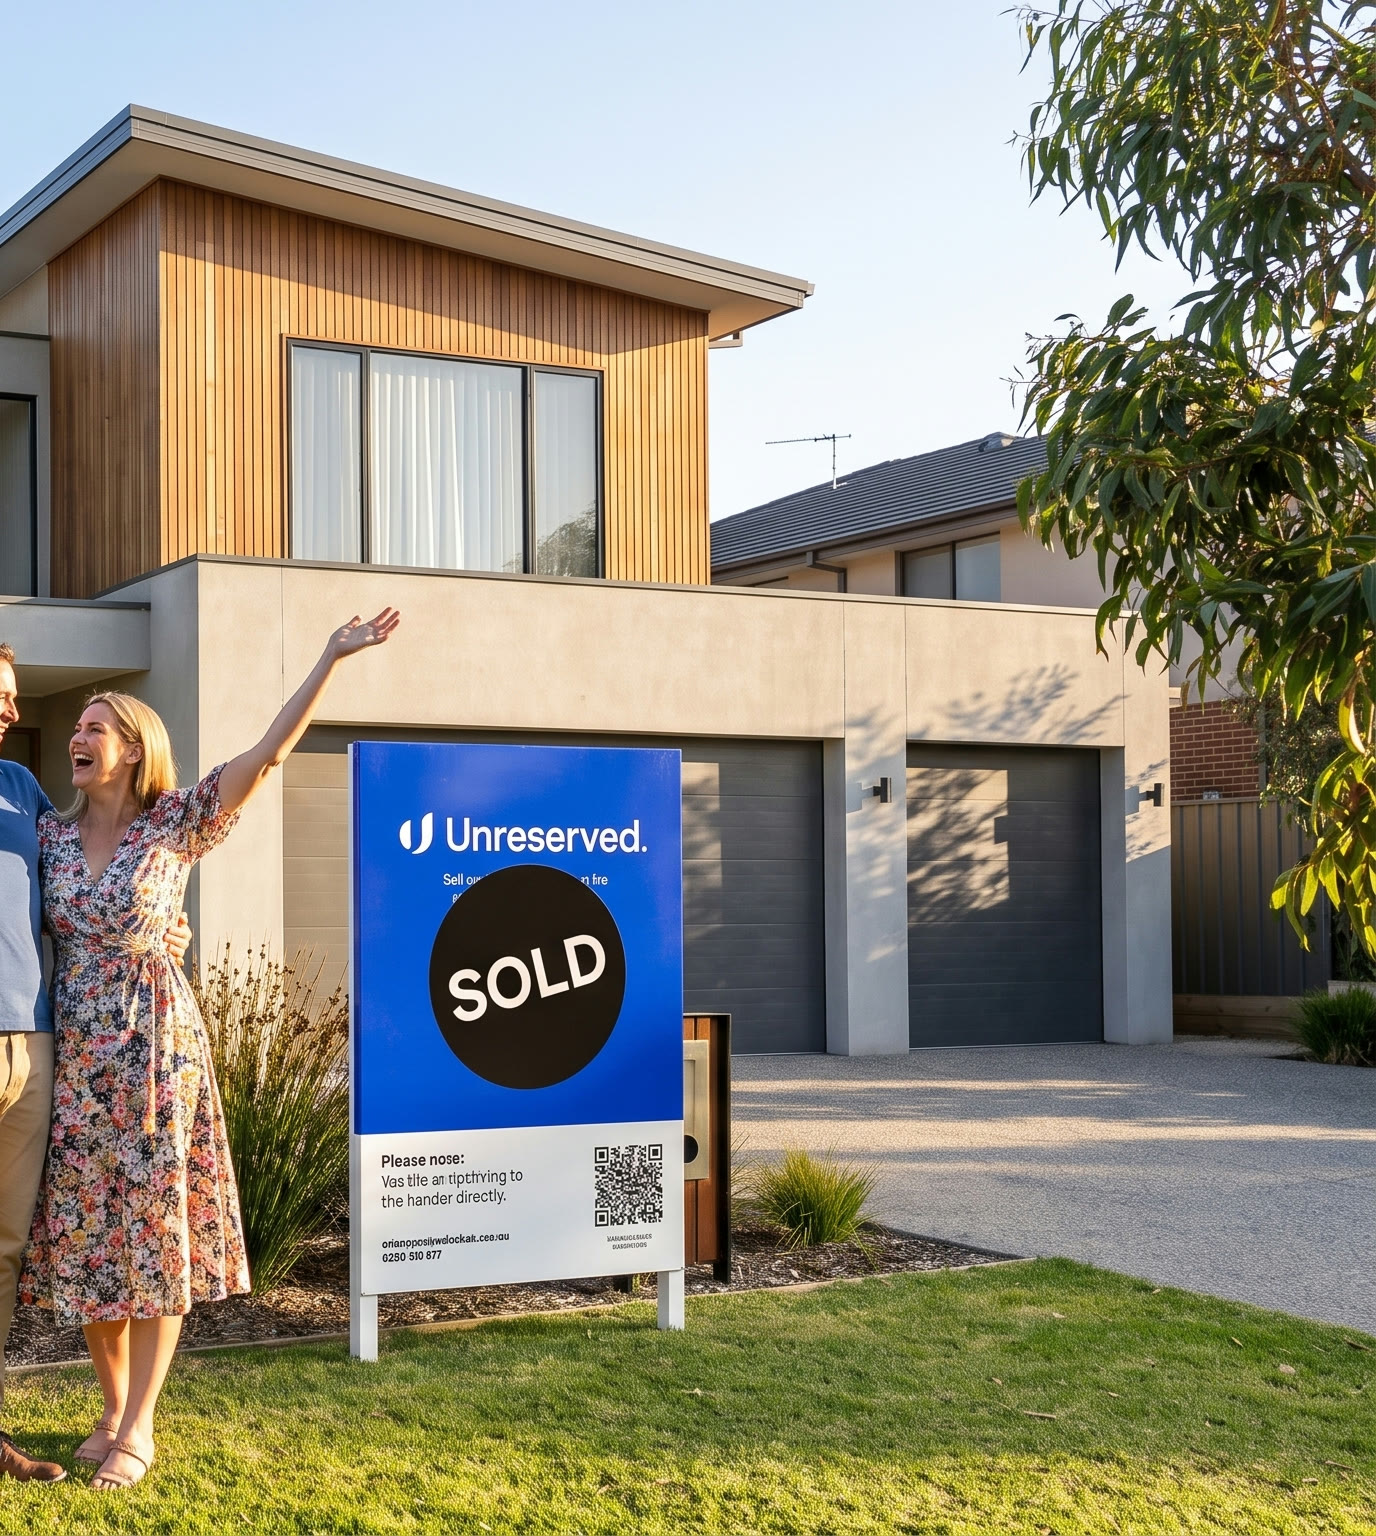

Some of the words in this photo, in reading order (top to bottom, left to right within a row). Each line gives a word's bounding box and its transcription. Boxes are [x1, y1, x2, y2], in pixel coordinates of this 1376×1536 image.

[445, 816, 648, 853] Unreserved.
[443, 873, 464, 886] Sell
[448, 934, 606, 1022] SOLD
[381, 1154, 426, 1168] Please
[510, 1169, 523, 1182] to
[381, 1194, 404, 1208] the
[407, 1192, 453, 1207] hander
[456, 1188, 507, 1205] directly.
[426, 1250, 442, 1260] 877
